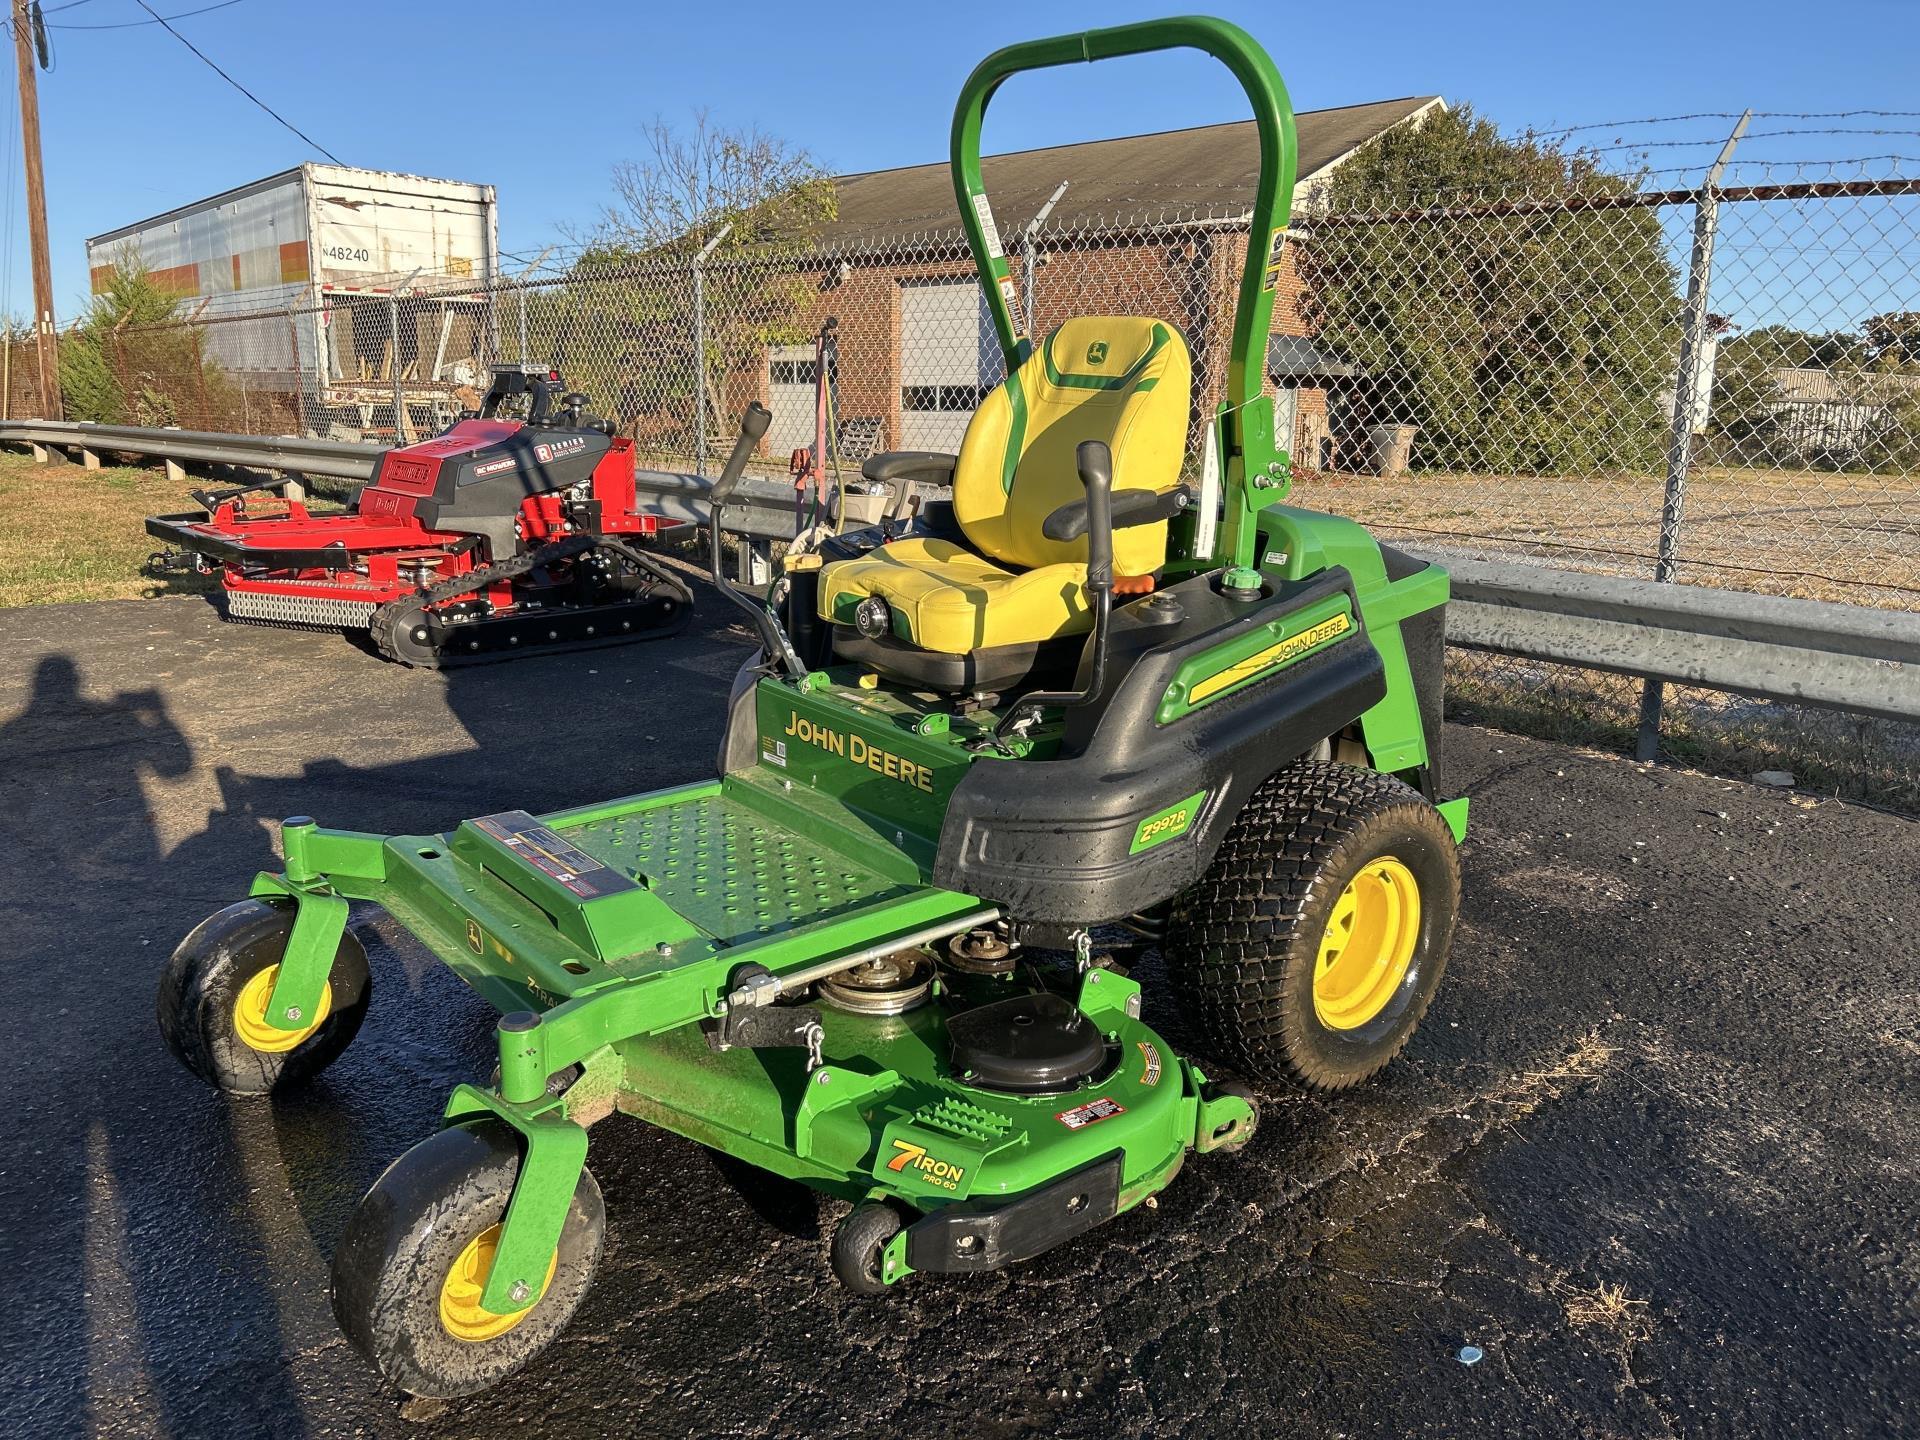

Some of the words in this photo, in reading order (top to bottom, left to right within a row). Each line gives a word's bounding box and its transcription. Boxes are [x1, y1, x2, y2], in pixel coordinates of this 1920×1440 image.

[550, 437, 584, 451] SERIES
[486, 459, 516, 473] MOWERS
[1275, 635, 1308, 660] JOHN
[1309, 619, 1343, 645] DEERE
[785, 710, 845, 757] JOHN
[849, 733, 934, 794] DEERE
[1139, 809, 1187, 843] Z997R
[922, 1173, 942, 1186] PRO
[943, 1181, 957, 1191] 60
